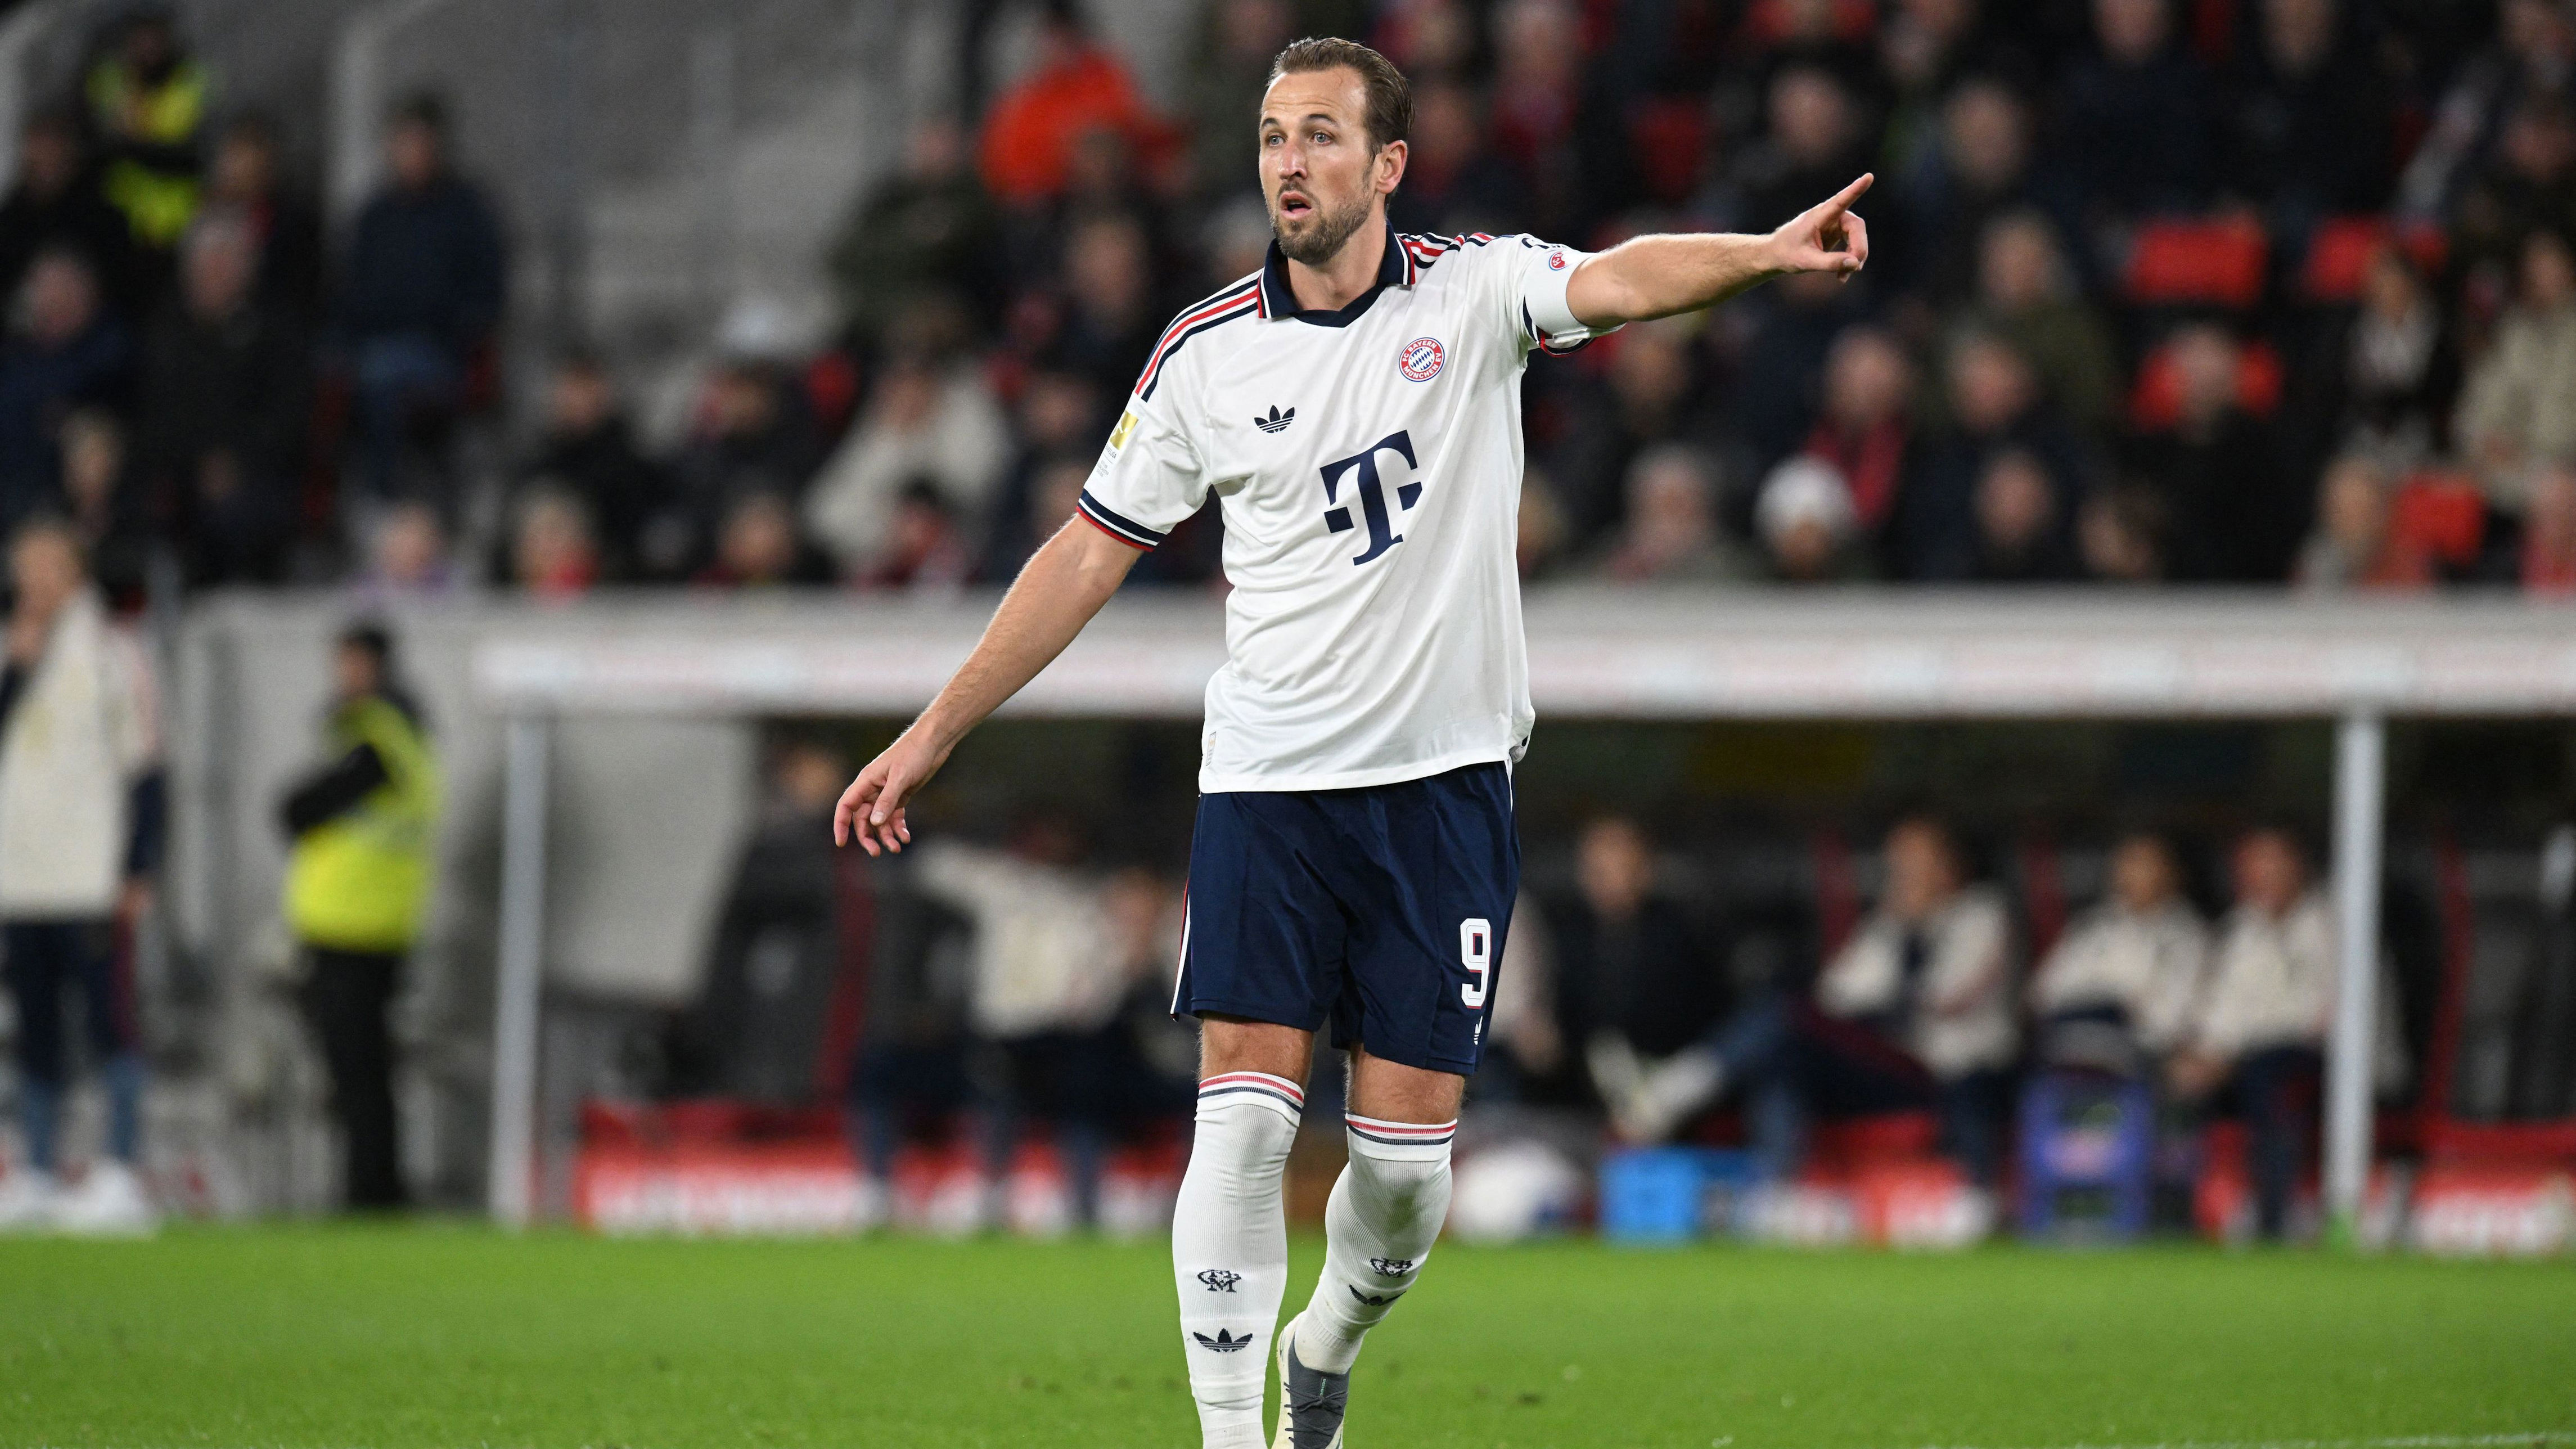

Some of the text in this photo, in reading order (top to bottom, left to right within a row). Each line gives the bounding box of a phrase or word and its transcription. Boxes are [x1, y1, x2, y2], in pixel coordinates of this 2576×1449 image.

[1402, 340, 1437, 362] FC BAYERN
[1319, 429, 1422, 566] T
[1460, 918, 1492, 1010] 9
